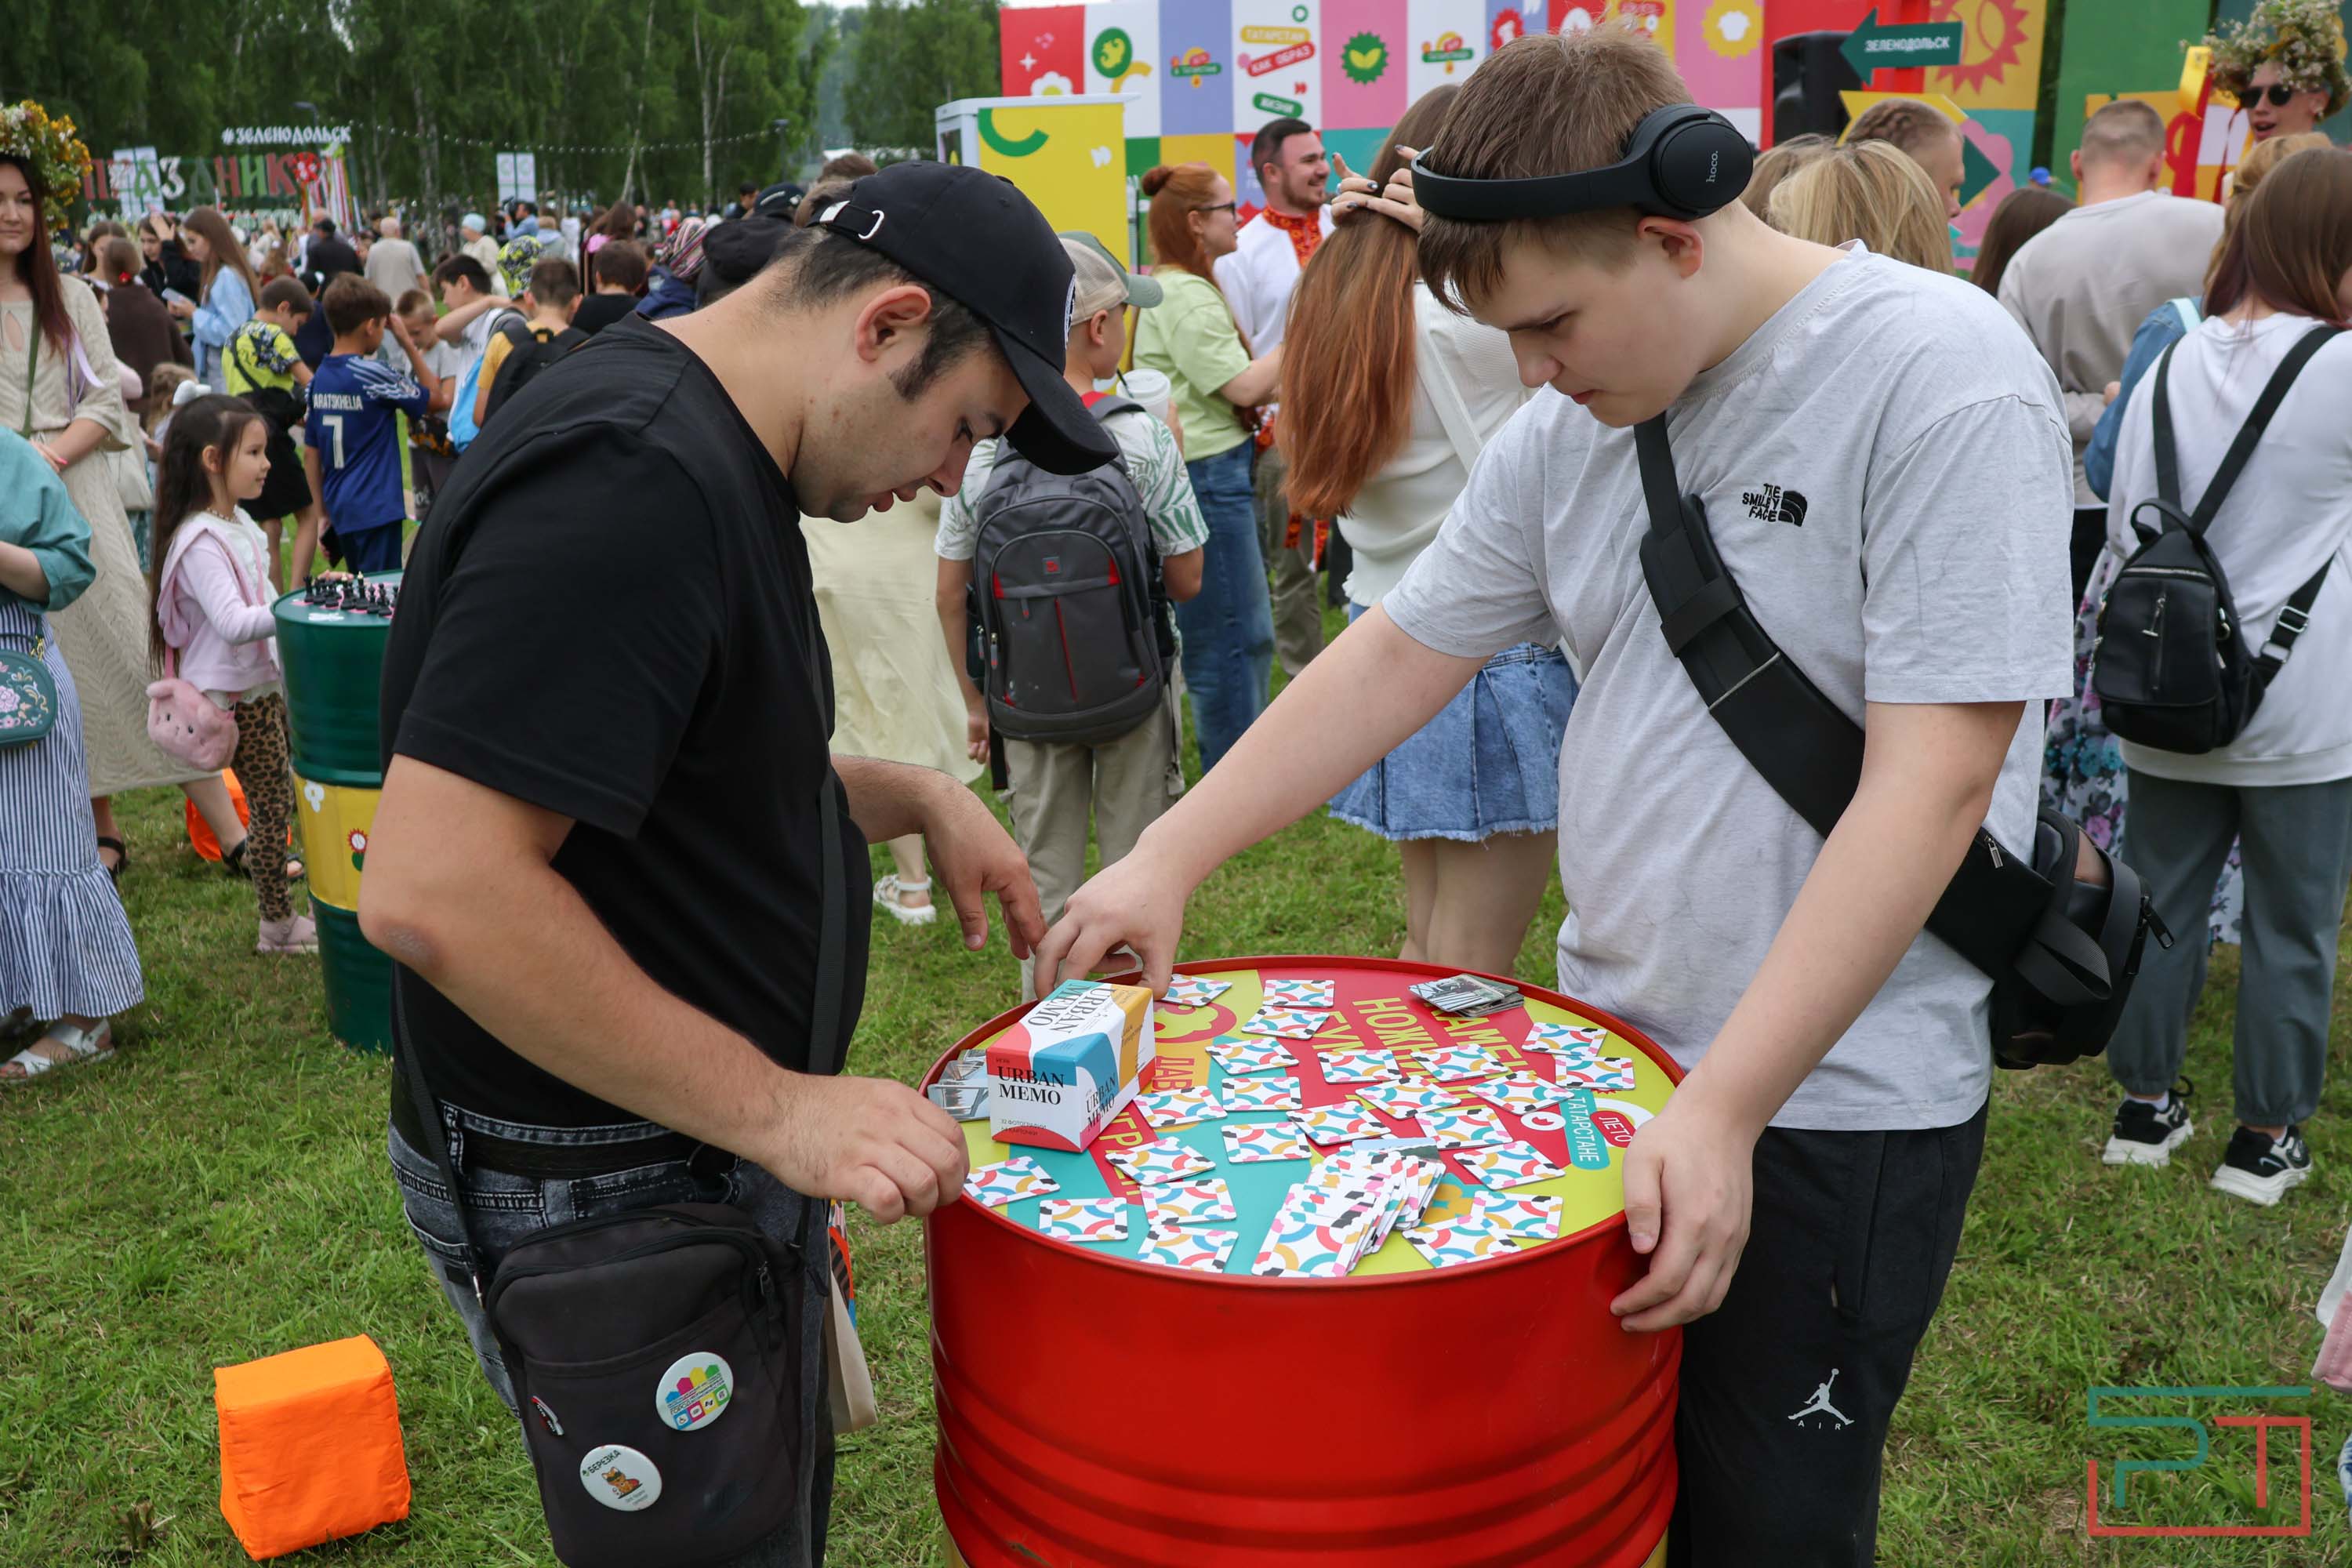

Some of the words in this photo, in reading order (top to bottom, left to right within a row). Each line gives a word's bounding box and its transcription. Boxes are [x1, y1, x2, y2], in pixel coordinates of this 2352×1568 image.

[1864, 36, 1950, 52] ЗЕЛЕНОДОЛЬСК
[222, 125, 351, 145] #ЗЕЛЕНОДОЛЬСК
[322, 415, 344, 469] 7
[1748, 506, 1777, 522] FACE
[1028, 983, 1091, 1026] MEMO
[1049, 988, 1115, 1034] URBAN
[997, 1065, 1064, 1088] URBAN
[999, 1083, 1061, 1105] MEMO
[1086, 1072, 1116, 1114] URBAN
[1087, 1094, 1115, 1131] MEMO
[1567, 1097, 1600, 1162] ТАТАРСТАНЕ
[1599, 1116, 1632, 1142] ЛЕТО
